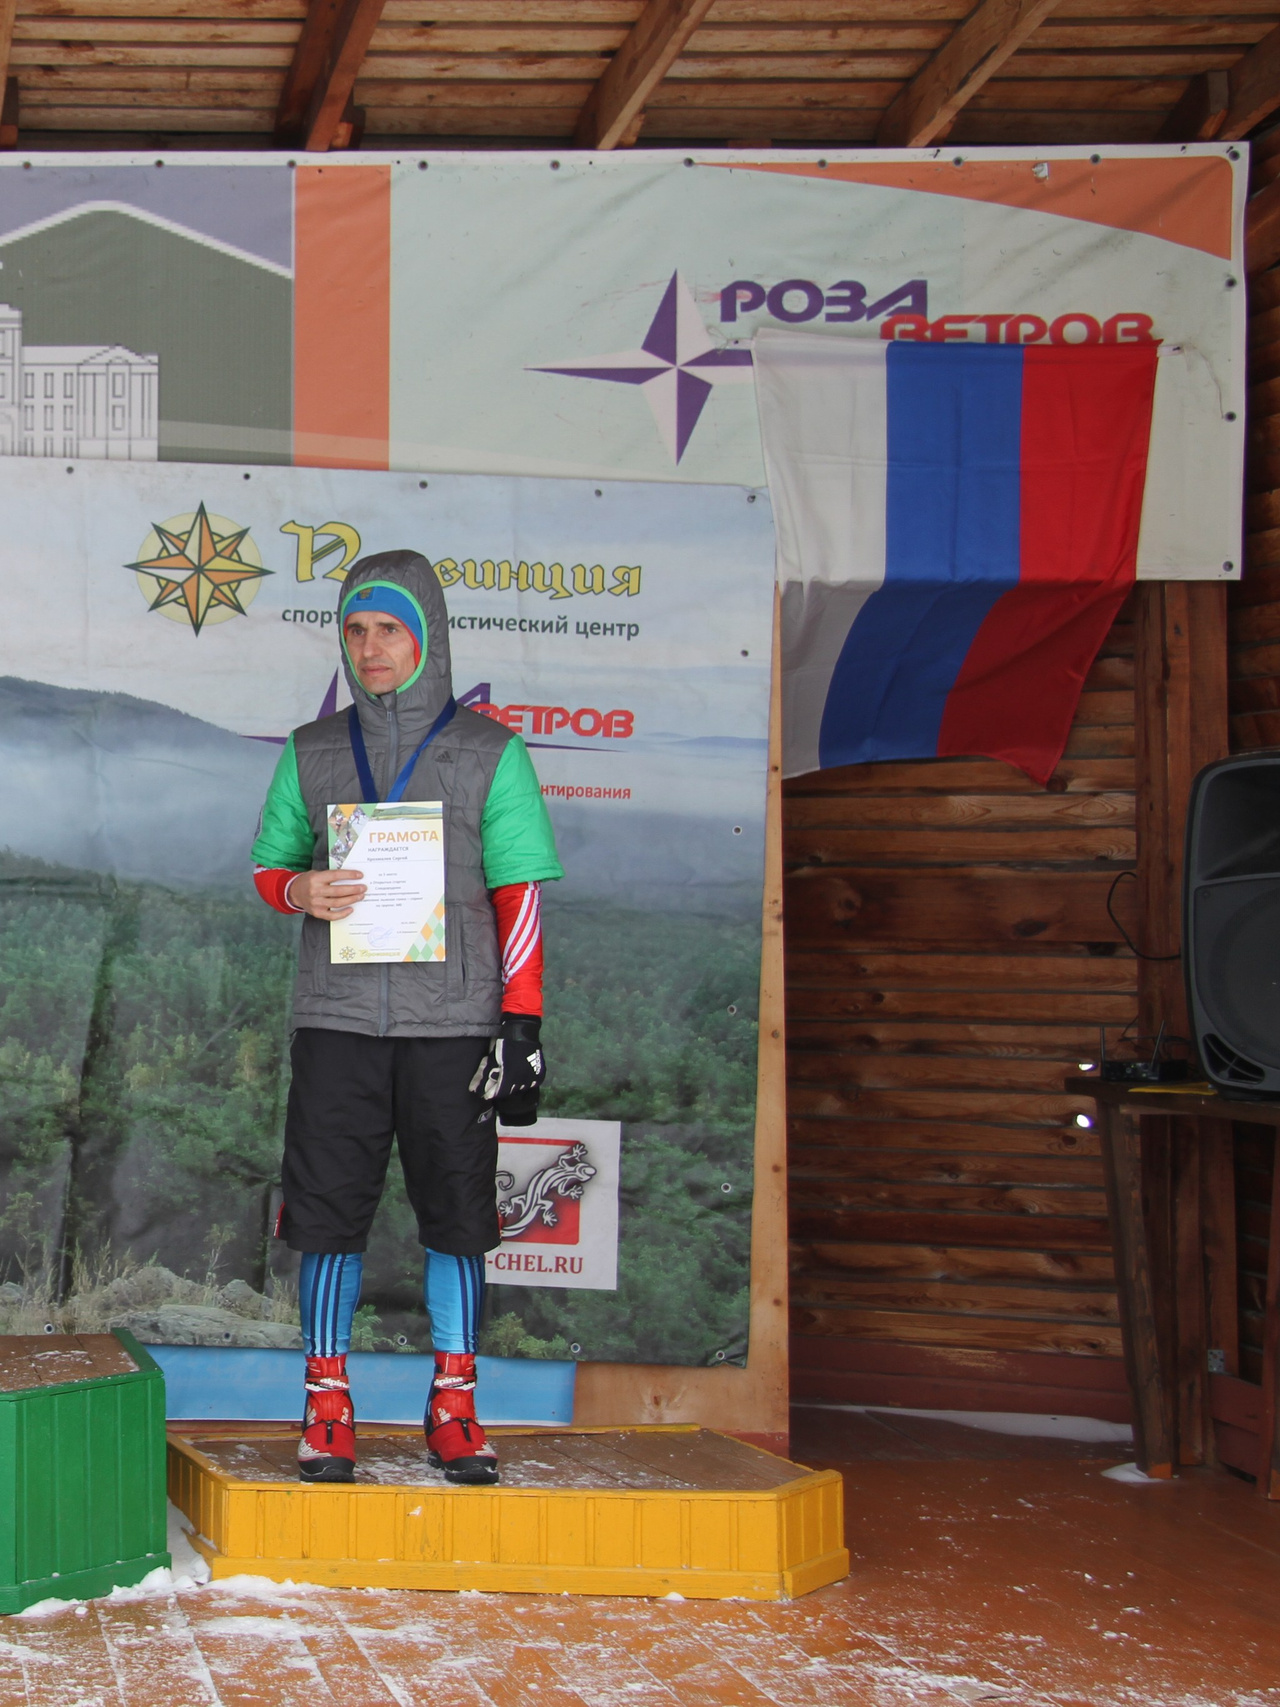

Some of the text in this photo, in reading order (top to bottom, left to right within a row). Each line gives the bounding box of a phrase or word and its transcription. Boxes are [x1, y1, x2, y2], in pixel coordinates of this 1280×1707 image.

[719, 279, 928, 323] РОЗА
[279, 519, 641, 600] Пвинция
[575, 621, 640, 641] центр
[541, 783, 631, 800] нтирования
[369, 830, 439, 843] ГРАМОТА
[484, 1252, 583, 1274] -CHEL.RU
